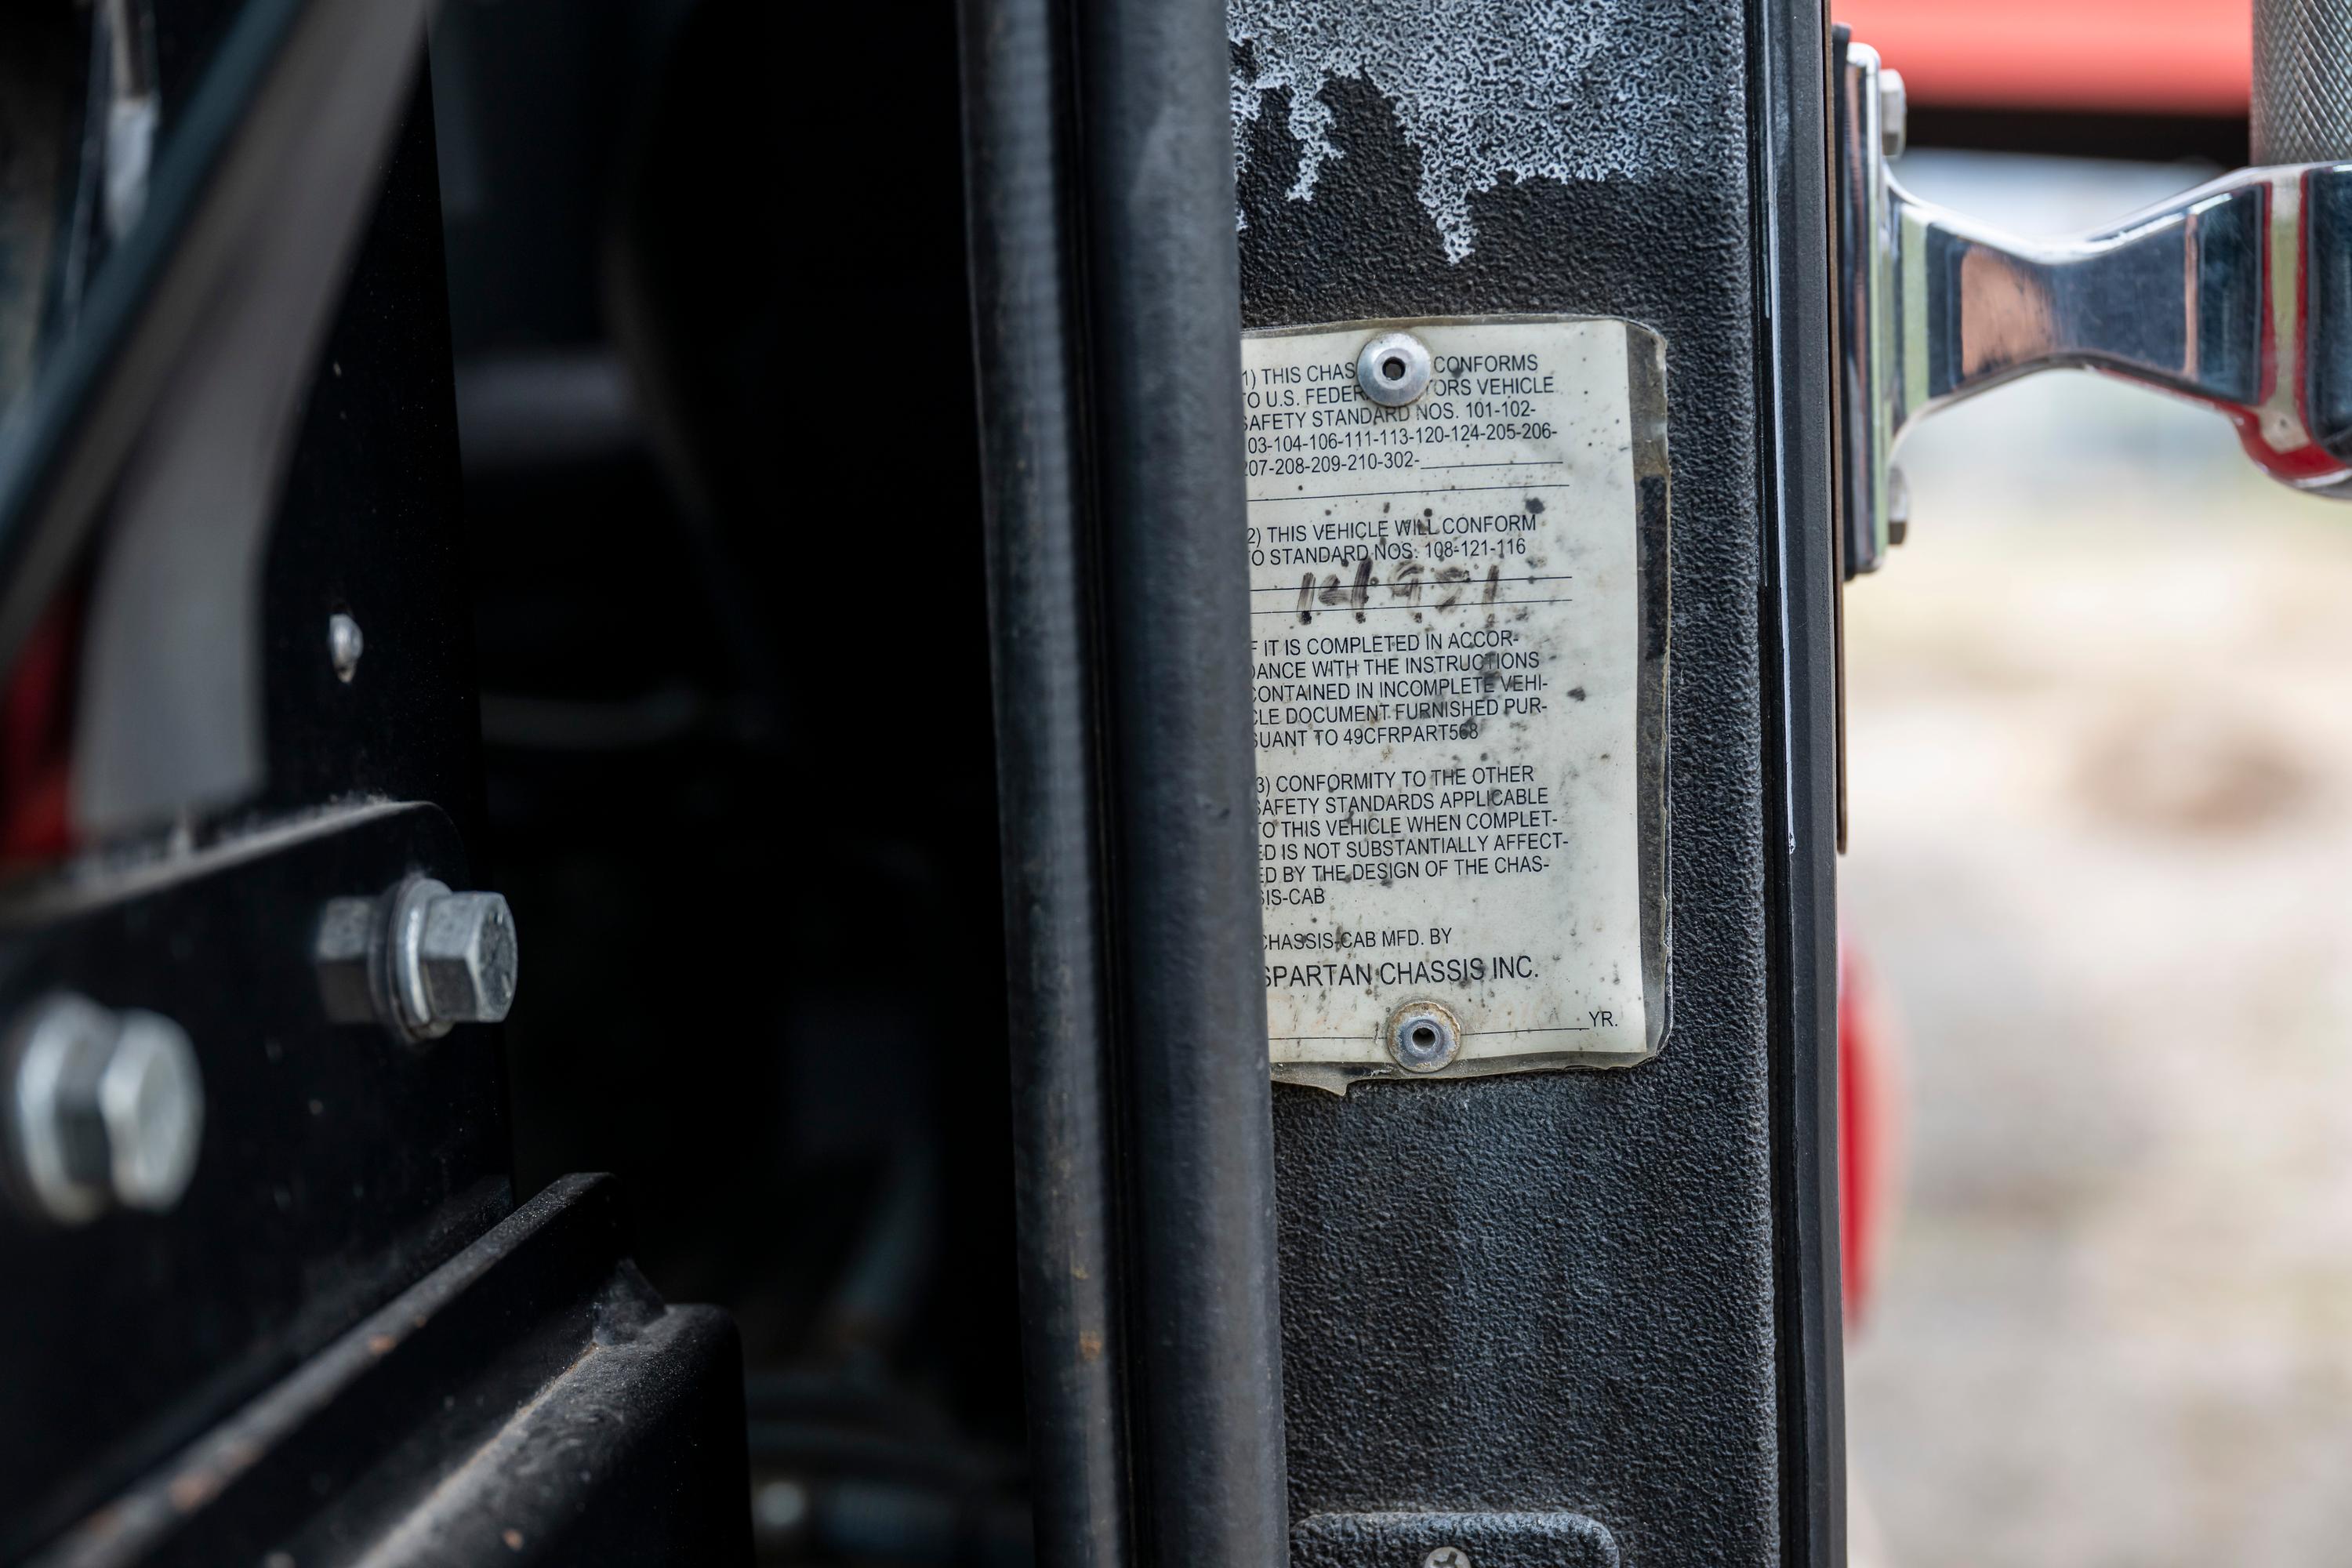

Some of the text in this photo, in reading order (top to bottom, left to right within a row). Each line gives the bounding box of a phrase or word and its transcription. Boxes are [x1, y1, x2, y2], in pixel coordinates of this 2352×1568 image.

[1242, 369, 1256, 390] 1)
[1261, 366, 1301, 385] THIS
[1434, 354, 1538, 373] CONFORMS
[1242, 391, 1260, 408] O
[1266, 390, 1300, 408] U.S.
[1305, 384, 1370, 405] FEDER
[1477, 376, 1555, 395] VEHICLE
[1312, 406, 1410, 427] STANDARD
[1416, 402, 1459, 420] NOS.
[1466, 401, 1536, 418] 101-102-
[1247, 422, 1558, 454] 03-104-106-111-113-120-124-205-206-
[1244, 452, 1420, 477] 07-208-209-210-302-
[1248, 514, 1537, 547] 2) THIS VEHICLE WILL CONFORM
[1248, 538, 1526, 566] O STANDARD NOS. 108-121-116
[1265, 640, 1279, 656] IT
[1285, 639, 1301, 656] IS
[1307, 634, 1420, 655] COMPLETED
[1426, 633, 1442, 650] IN
[1448, 630, 1519, 648] ACCOR-
[1252, 652, 1539, 679] ANCE WITH THE INSTRUCTIONS
[1356, 681, 1373, 699] IN
[1380, 676, 1494, 699] INCOMPLETE
[1501, 674, 1548, 692] VEHI-
[1287, 704, 1390, 724] DOCUMENT
[1396, 699, 1499, 720] FURNISHED
[1504, 697, 1548, 715] PUR-
[1313, 729, 1338, 746] TO
[1344, 723, 1479, 745] 49CFRPART568
[1257, 765, 1534, 797] 3) CONFORMITY TO THE OTHER
[1326, 793, 1435, 813] STANDARDS
[1440, 787, 1549, 808] APPLICABLE
[1258, 810, 1558, 838] O THIS VEHICLE WHEN COMPLET-
[1283, 844, 1298, 861] IS
[1305, 842, 1341, 860] NOT
[1346, 835, 1489, 858] SUBSTANTIALLY
[1494, 832, 1569, 851] AFFECT-
[1283, 866, 1306, 883] BY
[1312, 864, 1346, 881] THE
[1352, 862, 1420, 880] DESIGN
[1425, 859, 1449, 877] OF
[1454, 858, 1489, 875] THE
[1494, 855, 1550, 874] CHAS-
[1382, 929, 1425, 947] MFD.
[1430, 927, 1452, 945] BY
[1380, 957, 1486, 985] CHASSIS
[1493, 955, 1539, 979] INC.
[1588, 1011, 1619, 1028] YR.
